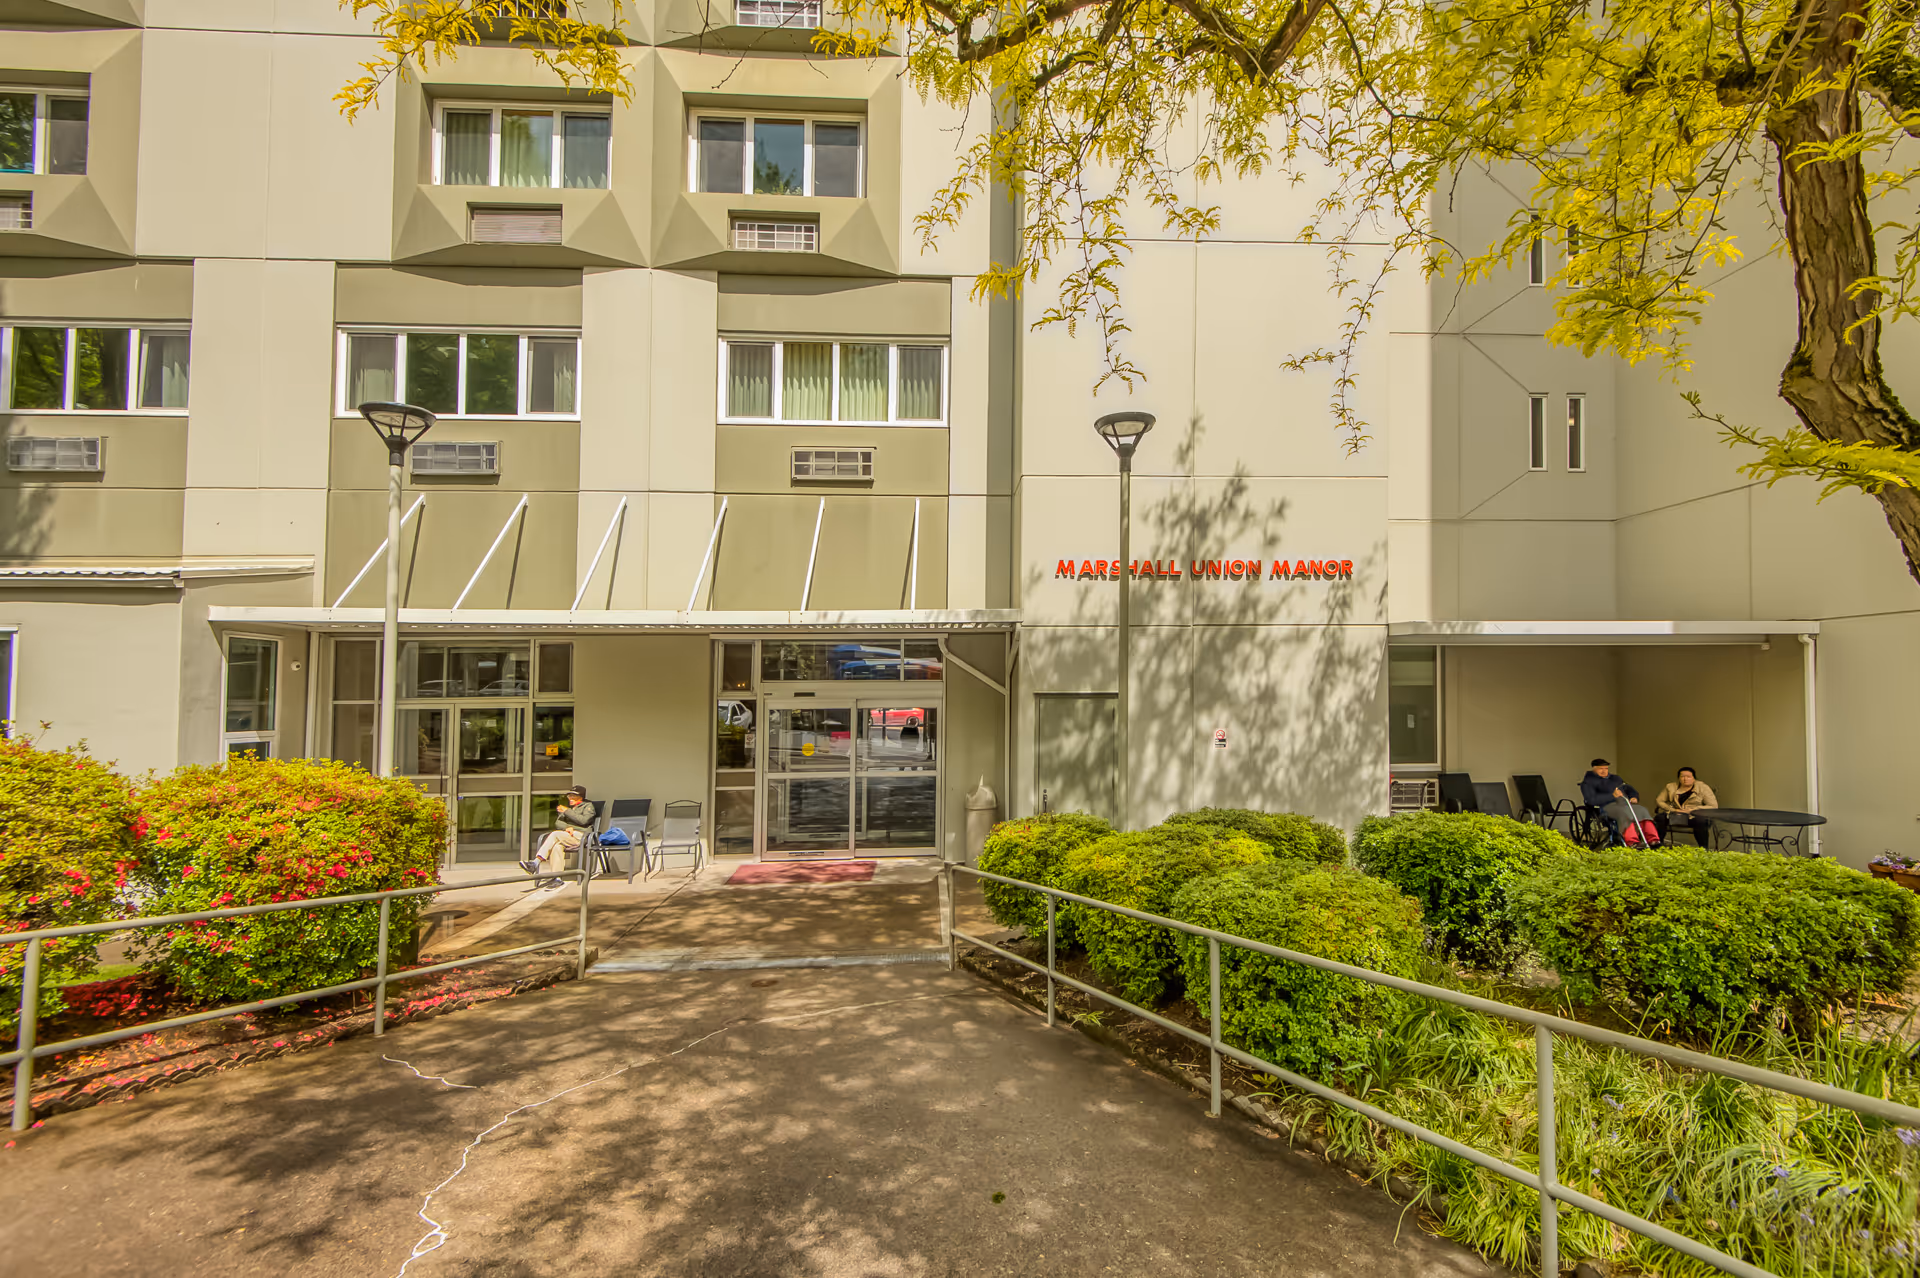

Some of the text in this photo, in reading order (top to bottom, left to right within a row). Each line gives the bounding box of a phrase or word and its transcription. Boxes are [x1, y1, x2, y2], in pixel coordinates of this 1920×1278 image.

[1056, 560, 1354, 576] MARSHALL UNION MANOR
